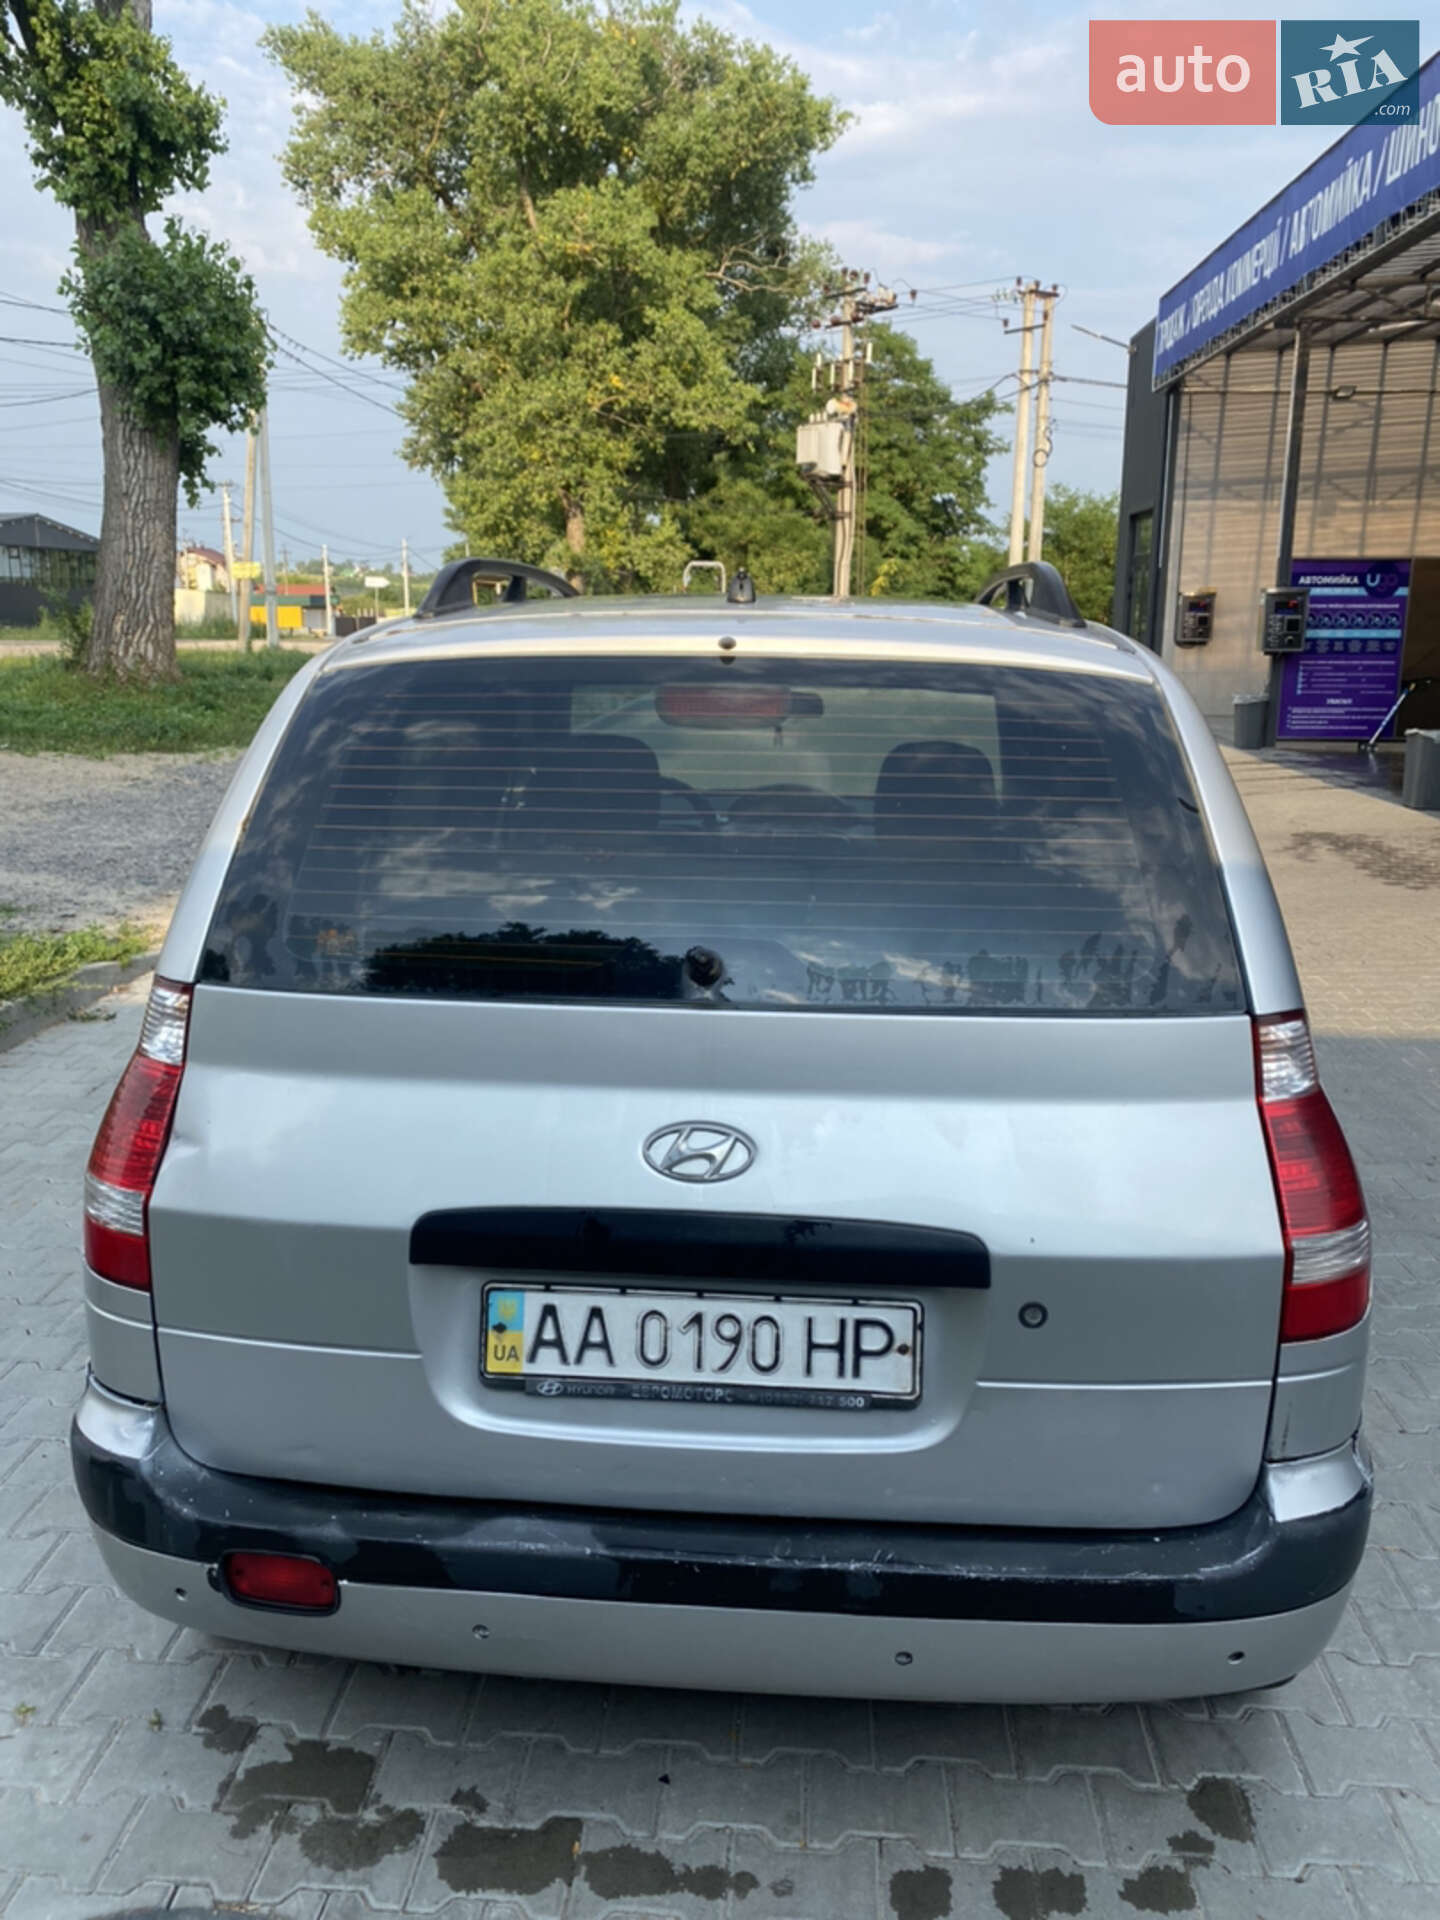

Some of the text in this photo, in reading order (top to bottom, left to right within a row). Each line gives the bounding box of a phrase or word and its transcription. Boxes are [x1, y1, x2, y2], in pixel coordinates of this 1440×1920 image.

[1288, 150, 1373, 260] АВТОМИЙКА
[1298, 573, 1360, 585] АВТОМИЙКА
[493, 1344, 519, 1362] UA
[527, 1303, 896, 1379] AA 0190 HP
